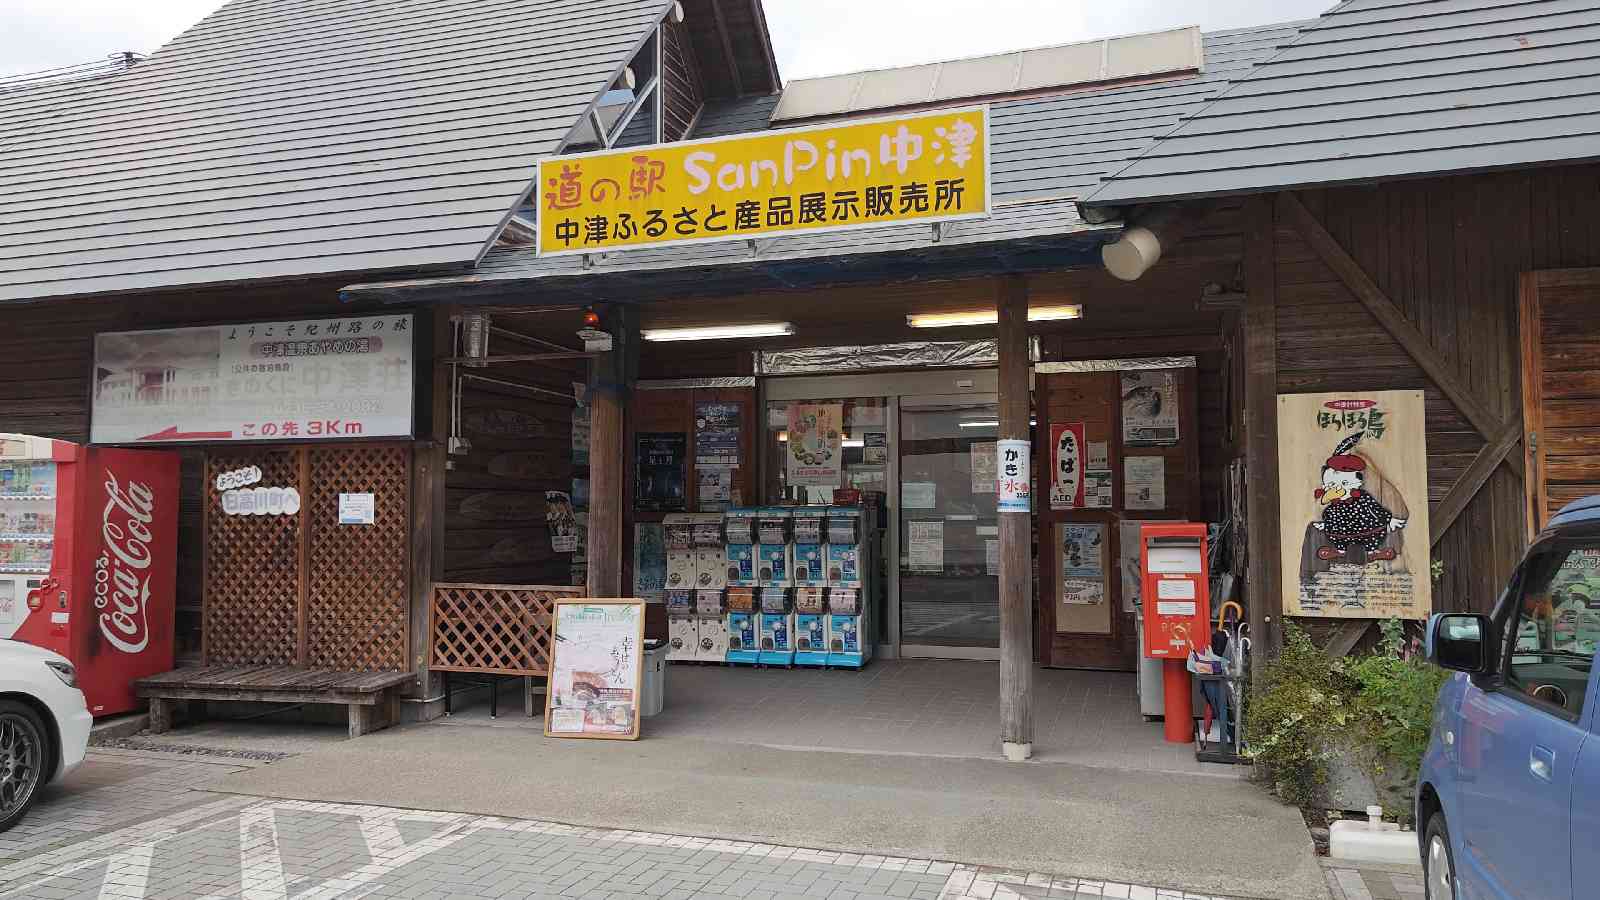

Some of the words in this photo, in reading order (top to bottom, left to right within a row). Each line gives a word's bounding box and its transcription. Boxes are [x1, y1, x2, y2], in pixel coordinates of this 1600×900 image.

[545, 155, 666, 211] 道の駅
[554, 177, 965, 247] 中津ふるさと産品展示販売所
[241, 421, 298, 436] この先
[306, 420, 363, 435] 3Km
[1317, 408, 1386, 440] ほろほろ鳥
[1004, 448, 1022, 493] かき氷
[1053, 494, 1071, 502] AED
[99, 467, 153, 654] Coca-Cola
[1161, 621, 1191, 634] POT
